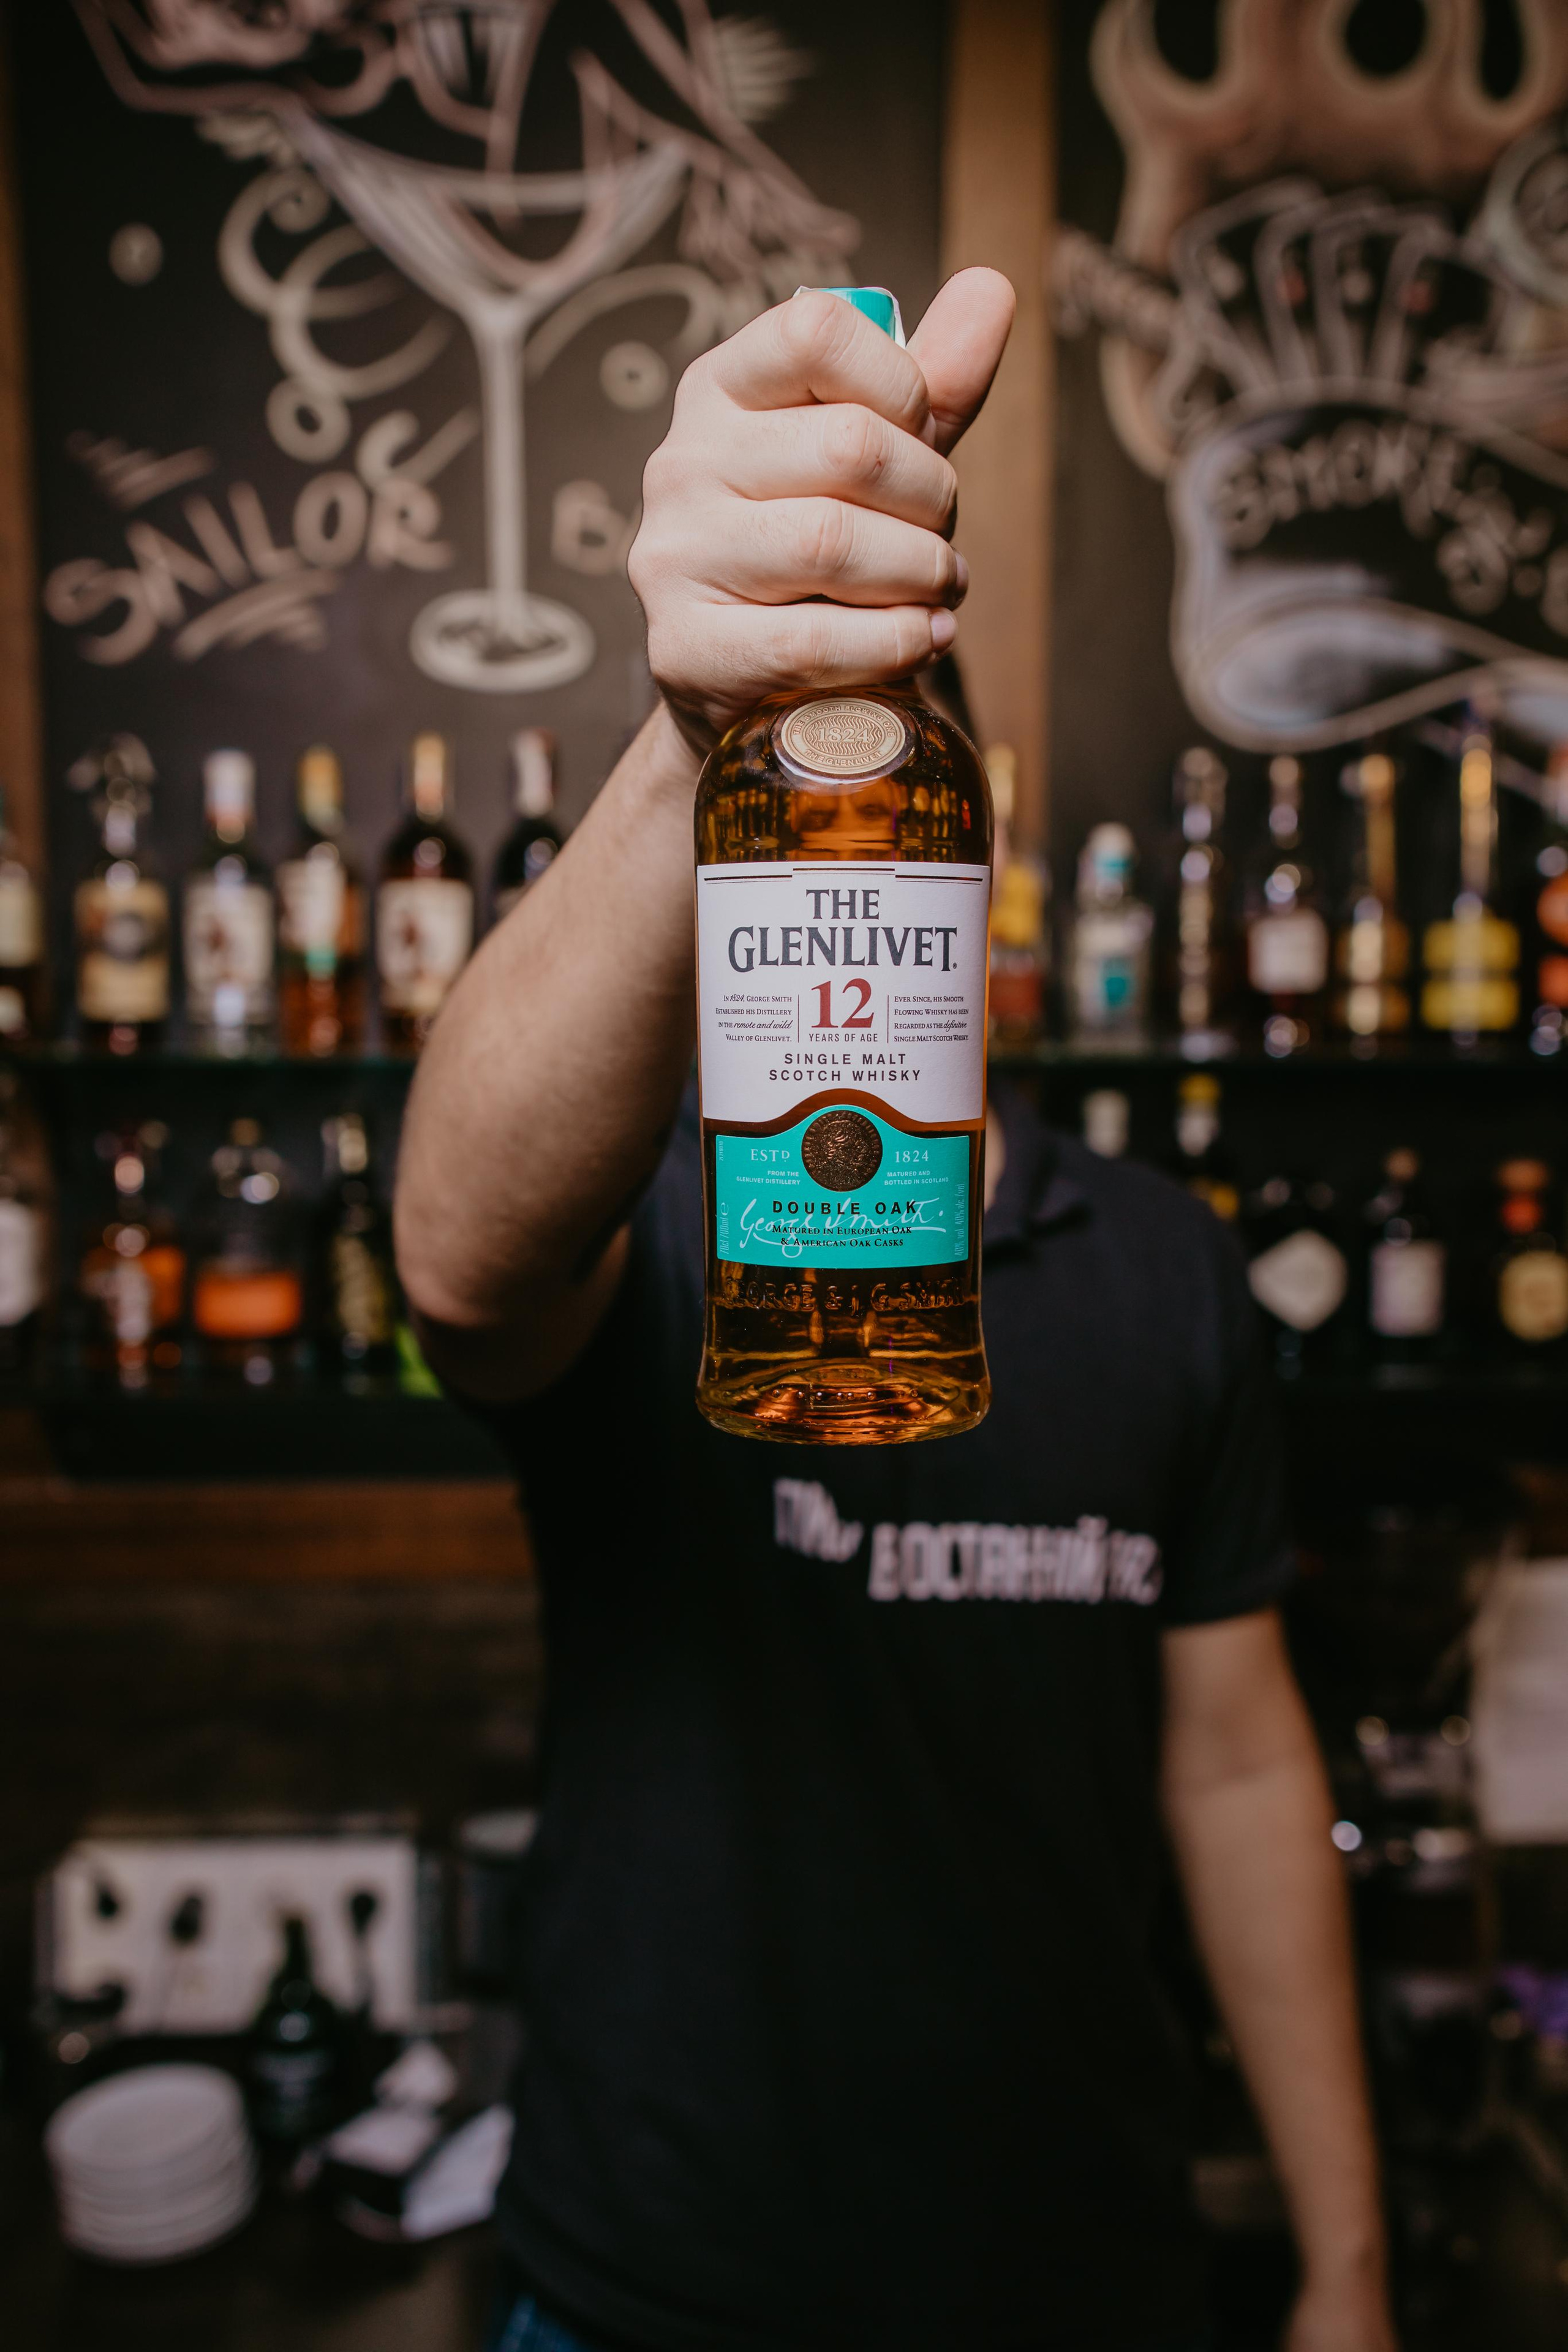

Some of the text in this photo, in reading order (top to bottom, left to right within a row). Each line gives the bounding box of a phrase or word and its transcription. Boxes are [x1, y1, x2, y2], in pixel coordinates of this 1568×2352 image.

[44, 470, 454, 665] SAILOR
[794, 706, 895, 737] THE SMOOTH FLOWING ONE
[818, 727, 870, 742] 1824
[804, 748, 882, 766] THE GLENLIVET
[806, 889, 880, 920] THE
[729, 993, 745, 1003] 1824,
[811, 978, 875, 1028] 12
[756, 1020, 774, 1028] and
[773, 1020, 793, 1028] wild
[943, 1019, 967, 1032] definitive
[809, 1033, 878, 1042] YEARS OF AGE
[785, 1054, 906, 1065] SINGLE MALT
[769, 1069, 921, 1082] SCOTCH WHISKY
[895, 1150, 929, 1163] 1824
[773, 1200, 916, 1215] DOUBLE OAK
[772, 1225, 820, 1234] MATURED
[837, 1227, 892, 1235] EUROPEAN
[794, 1238, 847, 1246] AMERICAN
